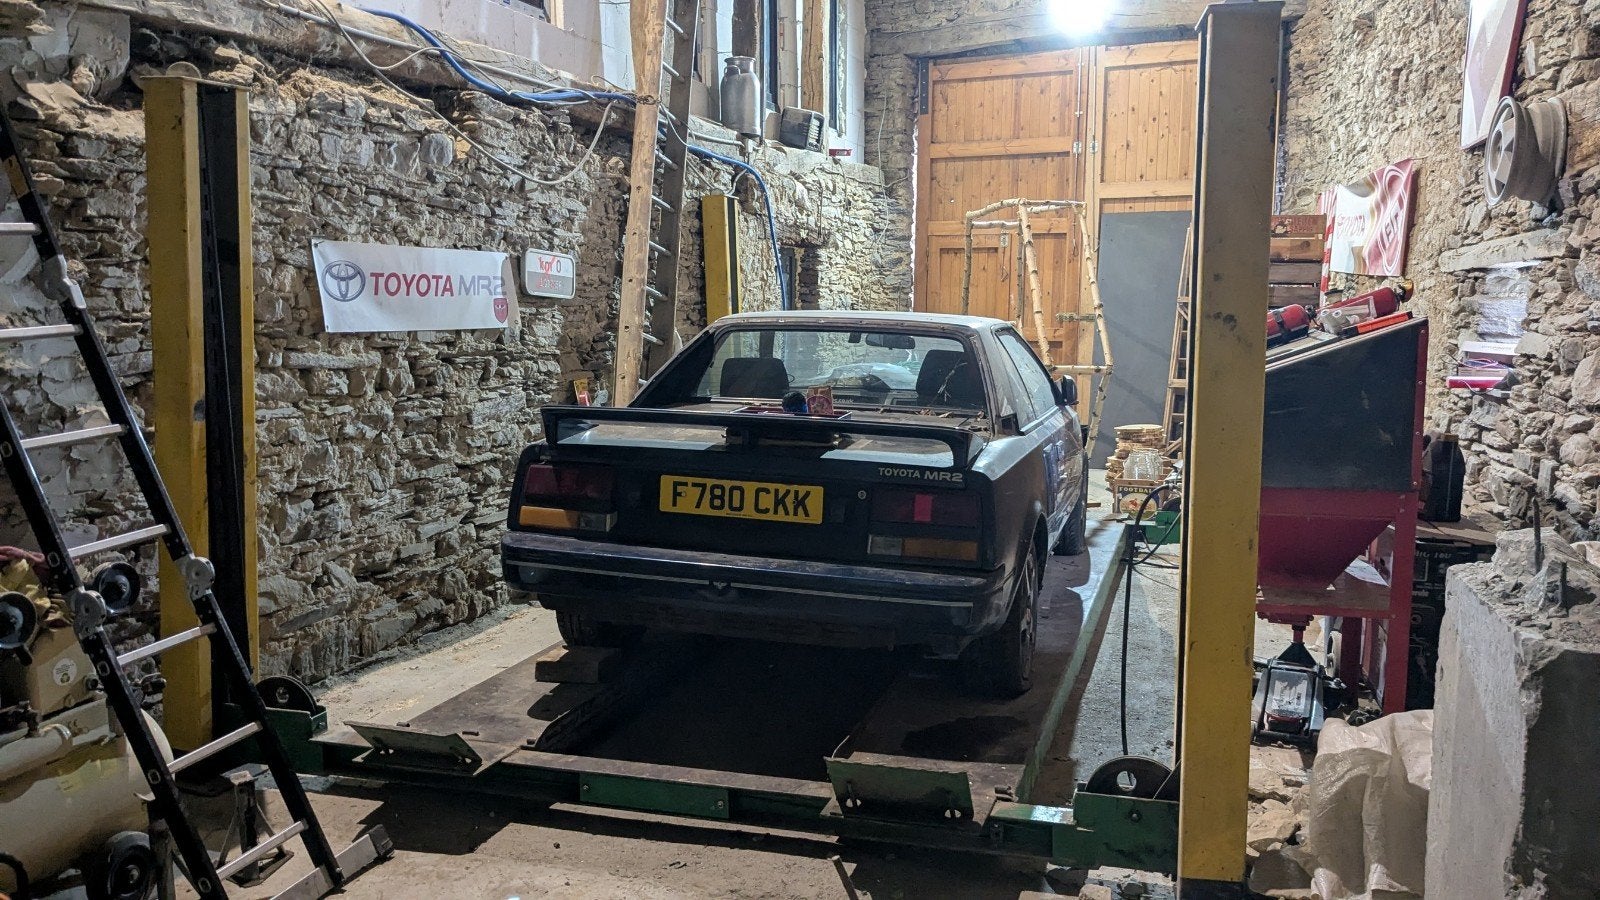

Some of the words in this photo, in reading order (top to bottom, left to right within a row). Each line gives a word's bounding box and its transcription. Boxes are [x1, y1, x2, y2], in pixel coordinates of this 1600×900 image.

[370, 272, 454, 297] TOYOTA
[458, 275, 507, 296] MR2
[878, 467, 921, 479] TOYOTA
[924, 470, 963, 482] MR2
[672, 480, 745, 512] F780
[754, 487, 811, 518] CKK
